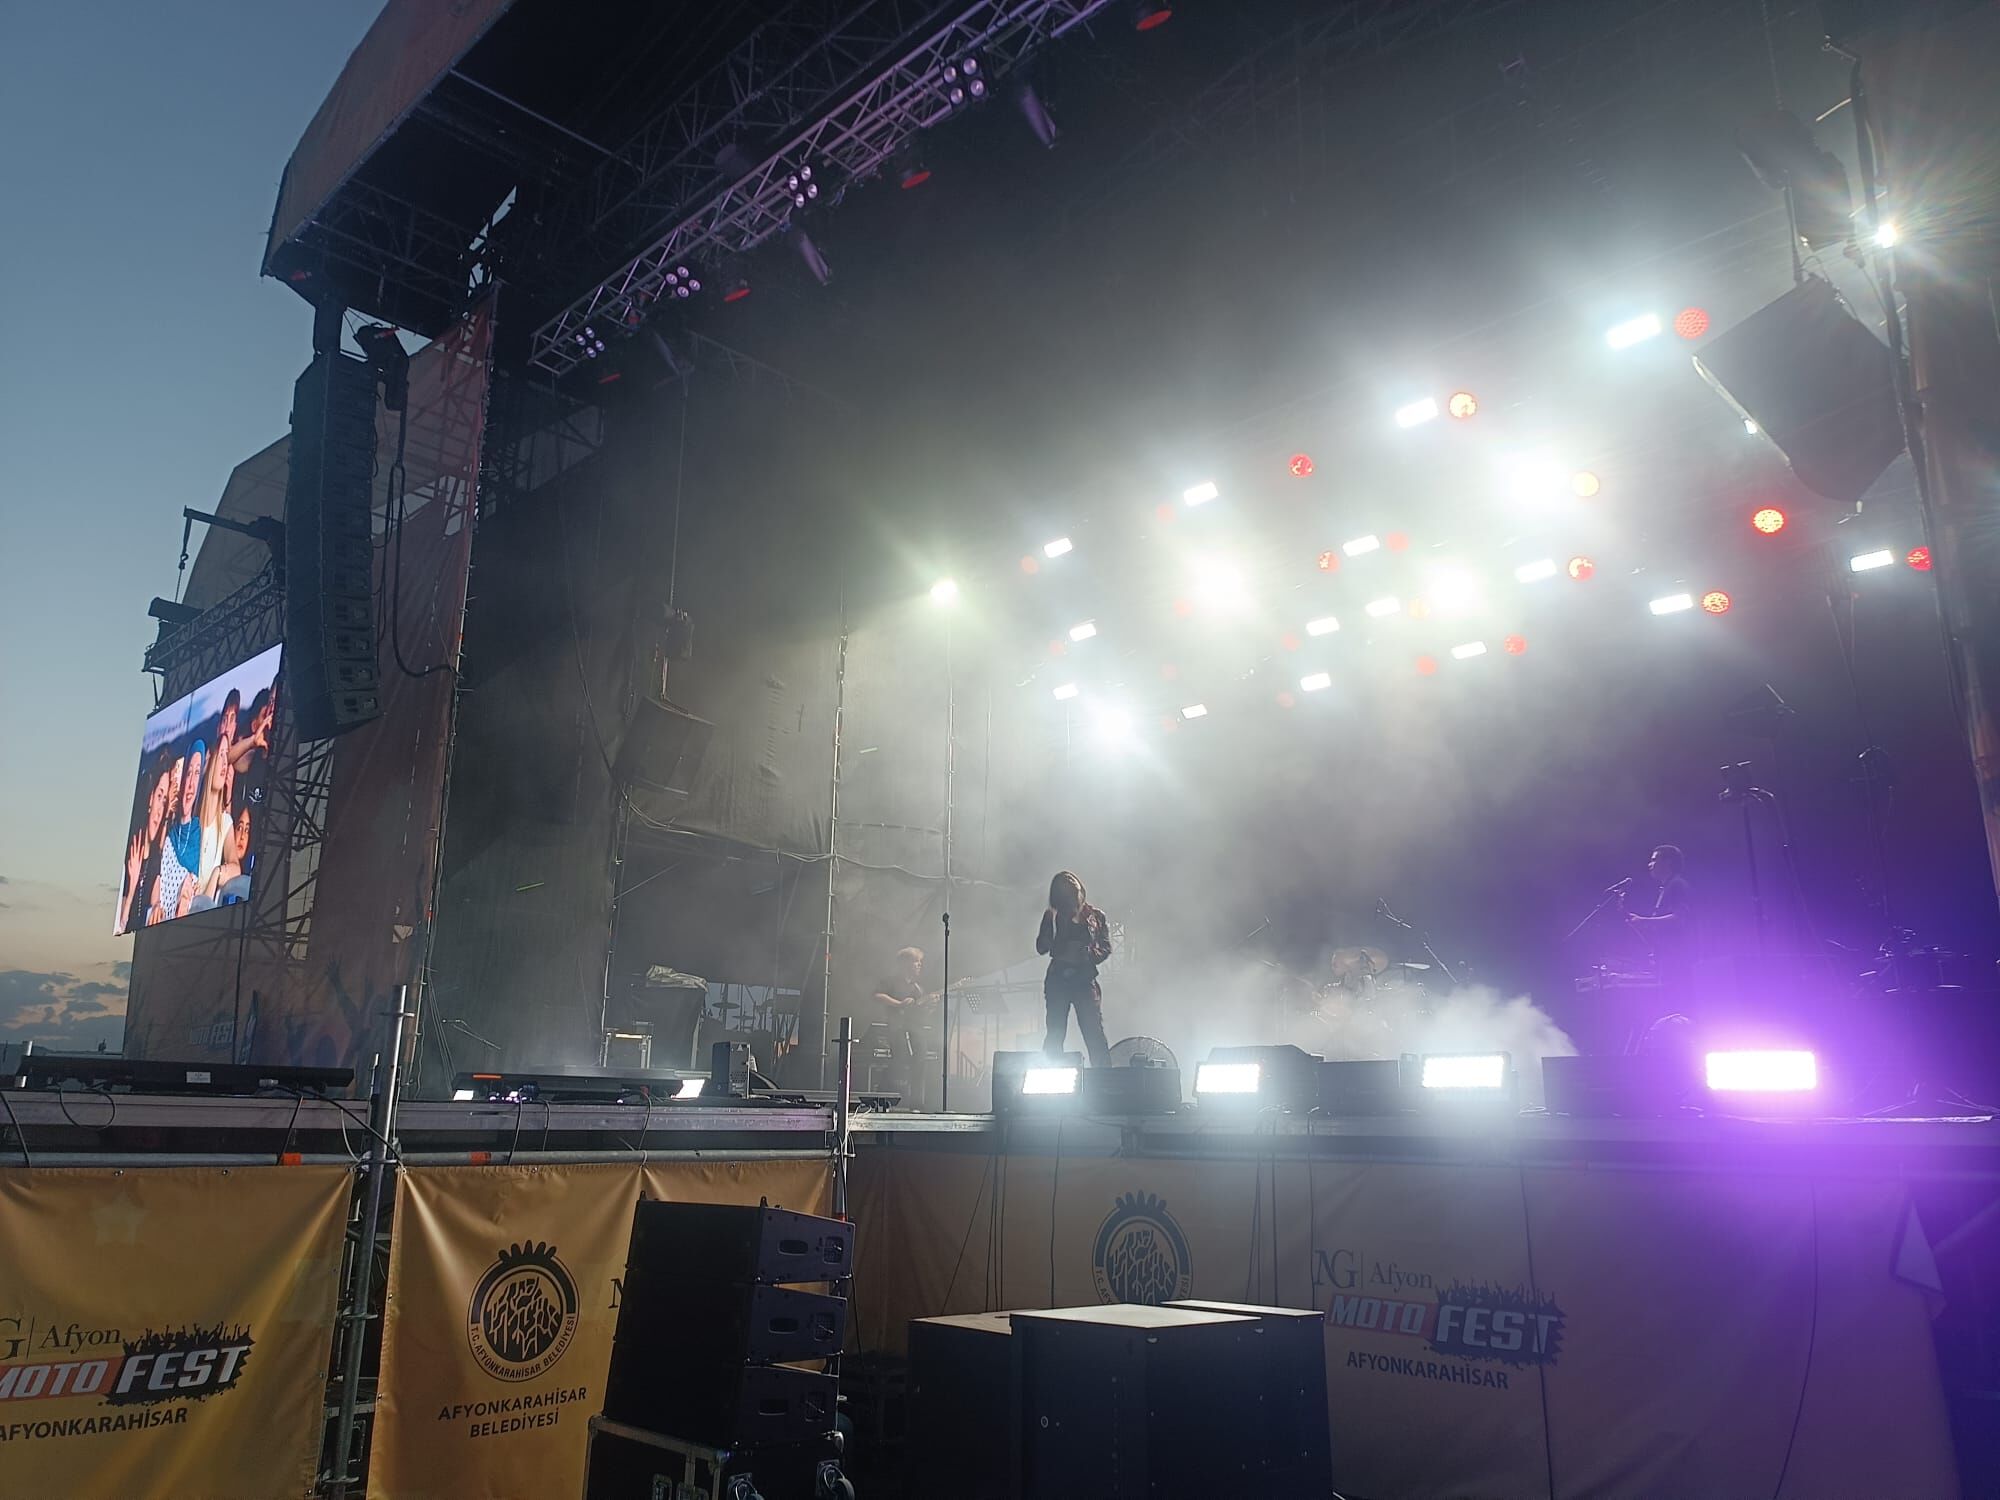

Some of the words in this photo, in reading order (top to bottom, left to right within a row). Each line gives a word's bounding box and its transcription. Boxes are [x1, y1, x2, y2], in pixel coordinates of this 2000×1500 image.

[1313, 1249, 1356, 1289] NG
[1369, 1261, 1432, 1293] Afyon
[39, 1323, 120, 1354] Afyon
[1331, 1295, 1426, 1334] MOTO
[1436, 1304, 1558, 1354] FEST
[115, 1345, 250, 1394] FEST
[1347, 1351, 1508, 1389] AFYONKARAHİSAR
[438, 1387, 587, 1421] AFYONKARAHİSAR
[470, 1408, 559, 1438] BELEDİYESİ
